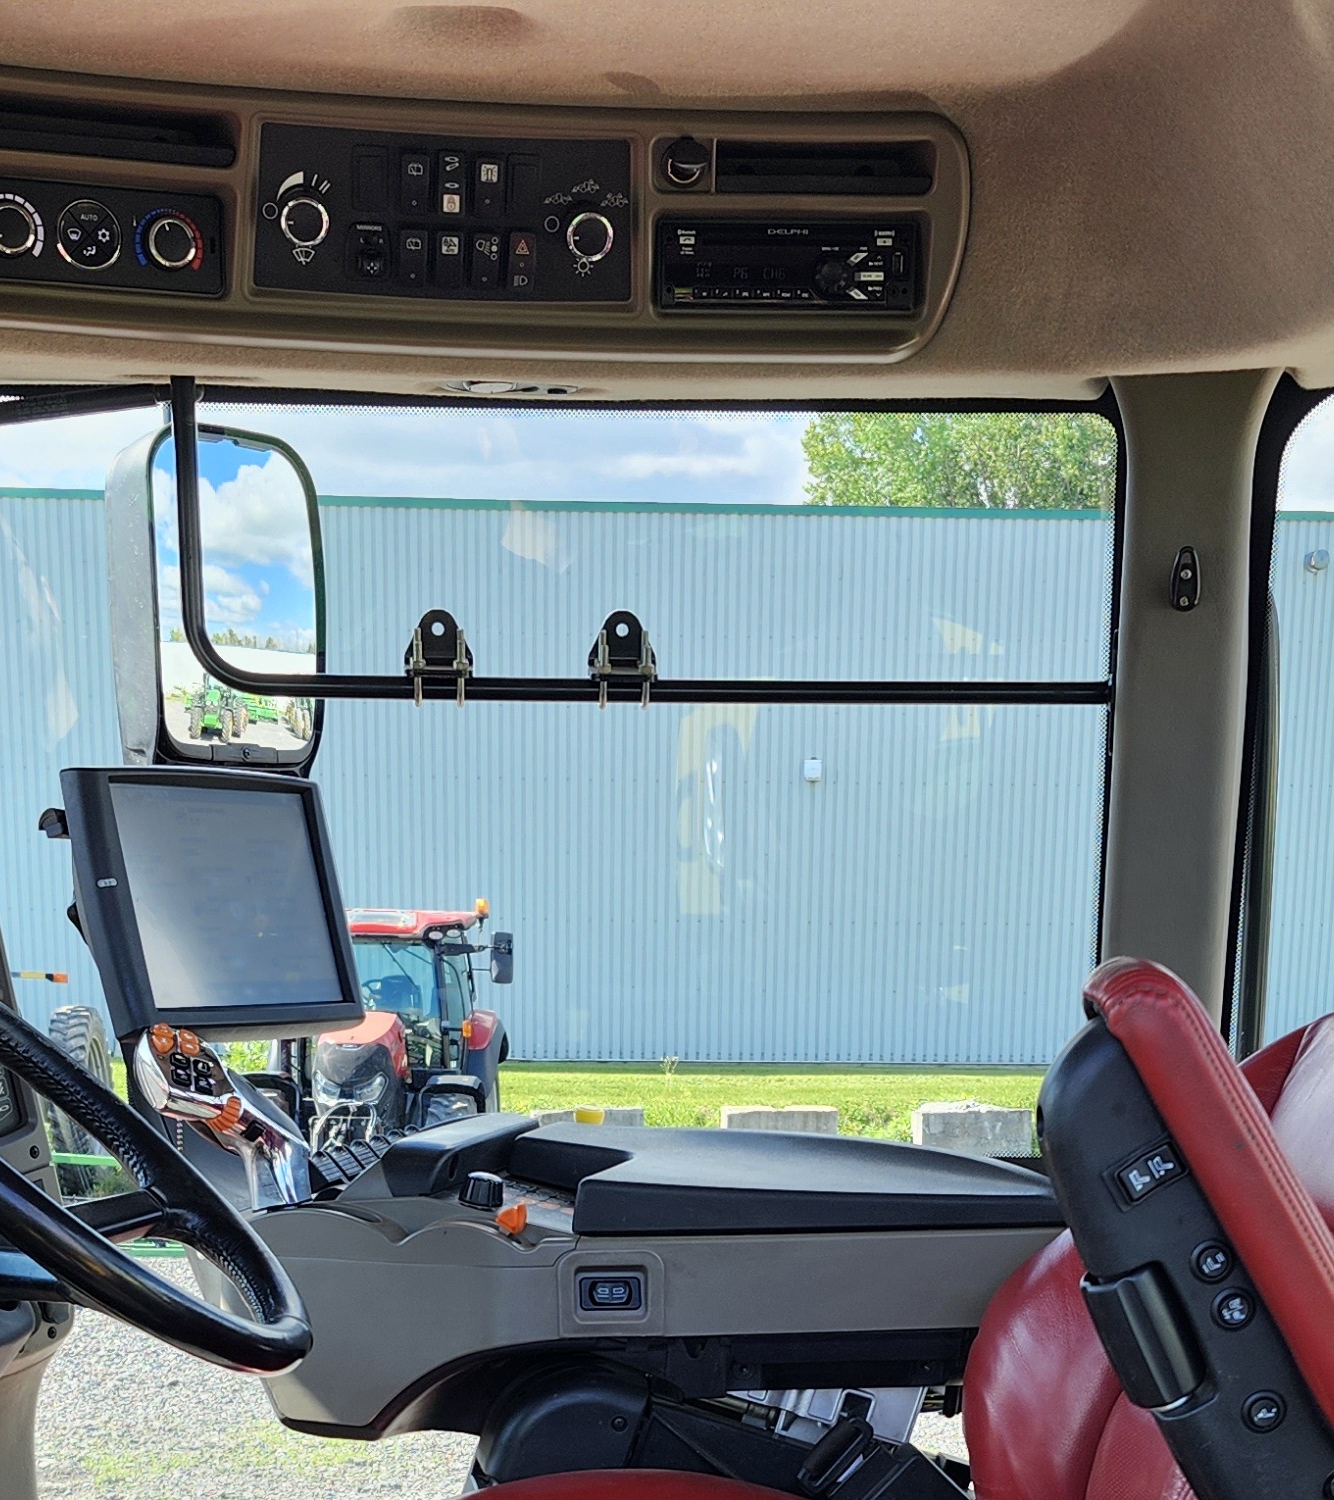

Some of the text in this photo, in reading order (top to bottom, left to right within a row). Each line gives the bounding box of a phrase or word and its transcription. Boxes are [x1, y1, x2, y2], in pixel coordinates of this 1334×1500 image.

[80, 213, 99, 222] AUTO
[356, 224, 383, 232] MIRRORS
[767, 228, 809, 236] DELPHI
